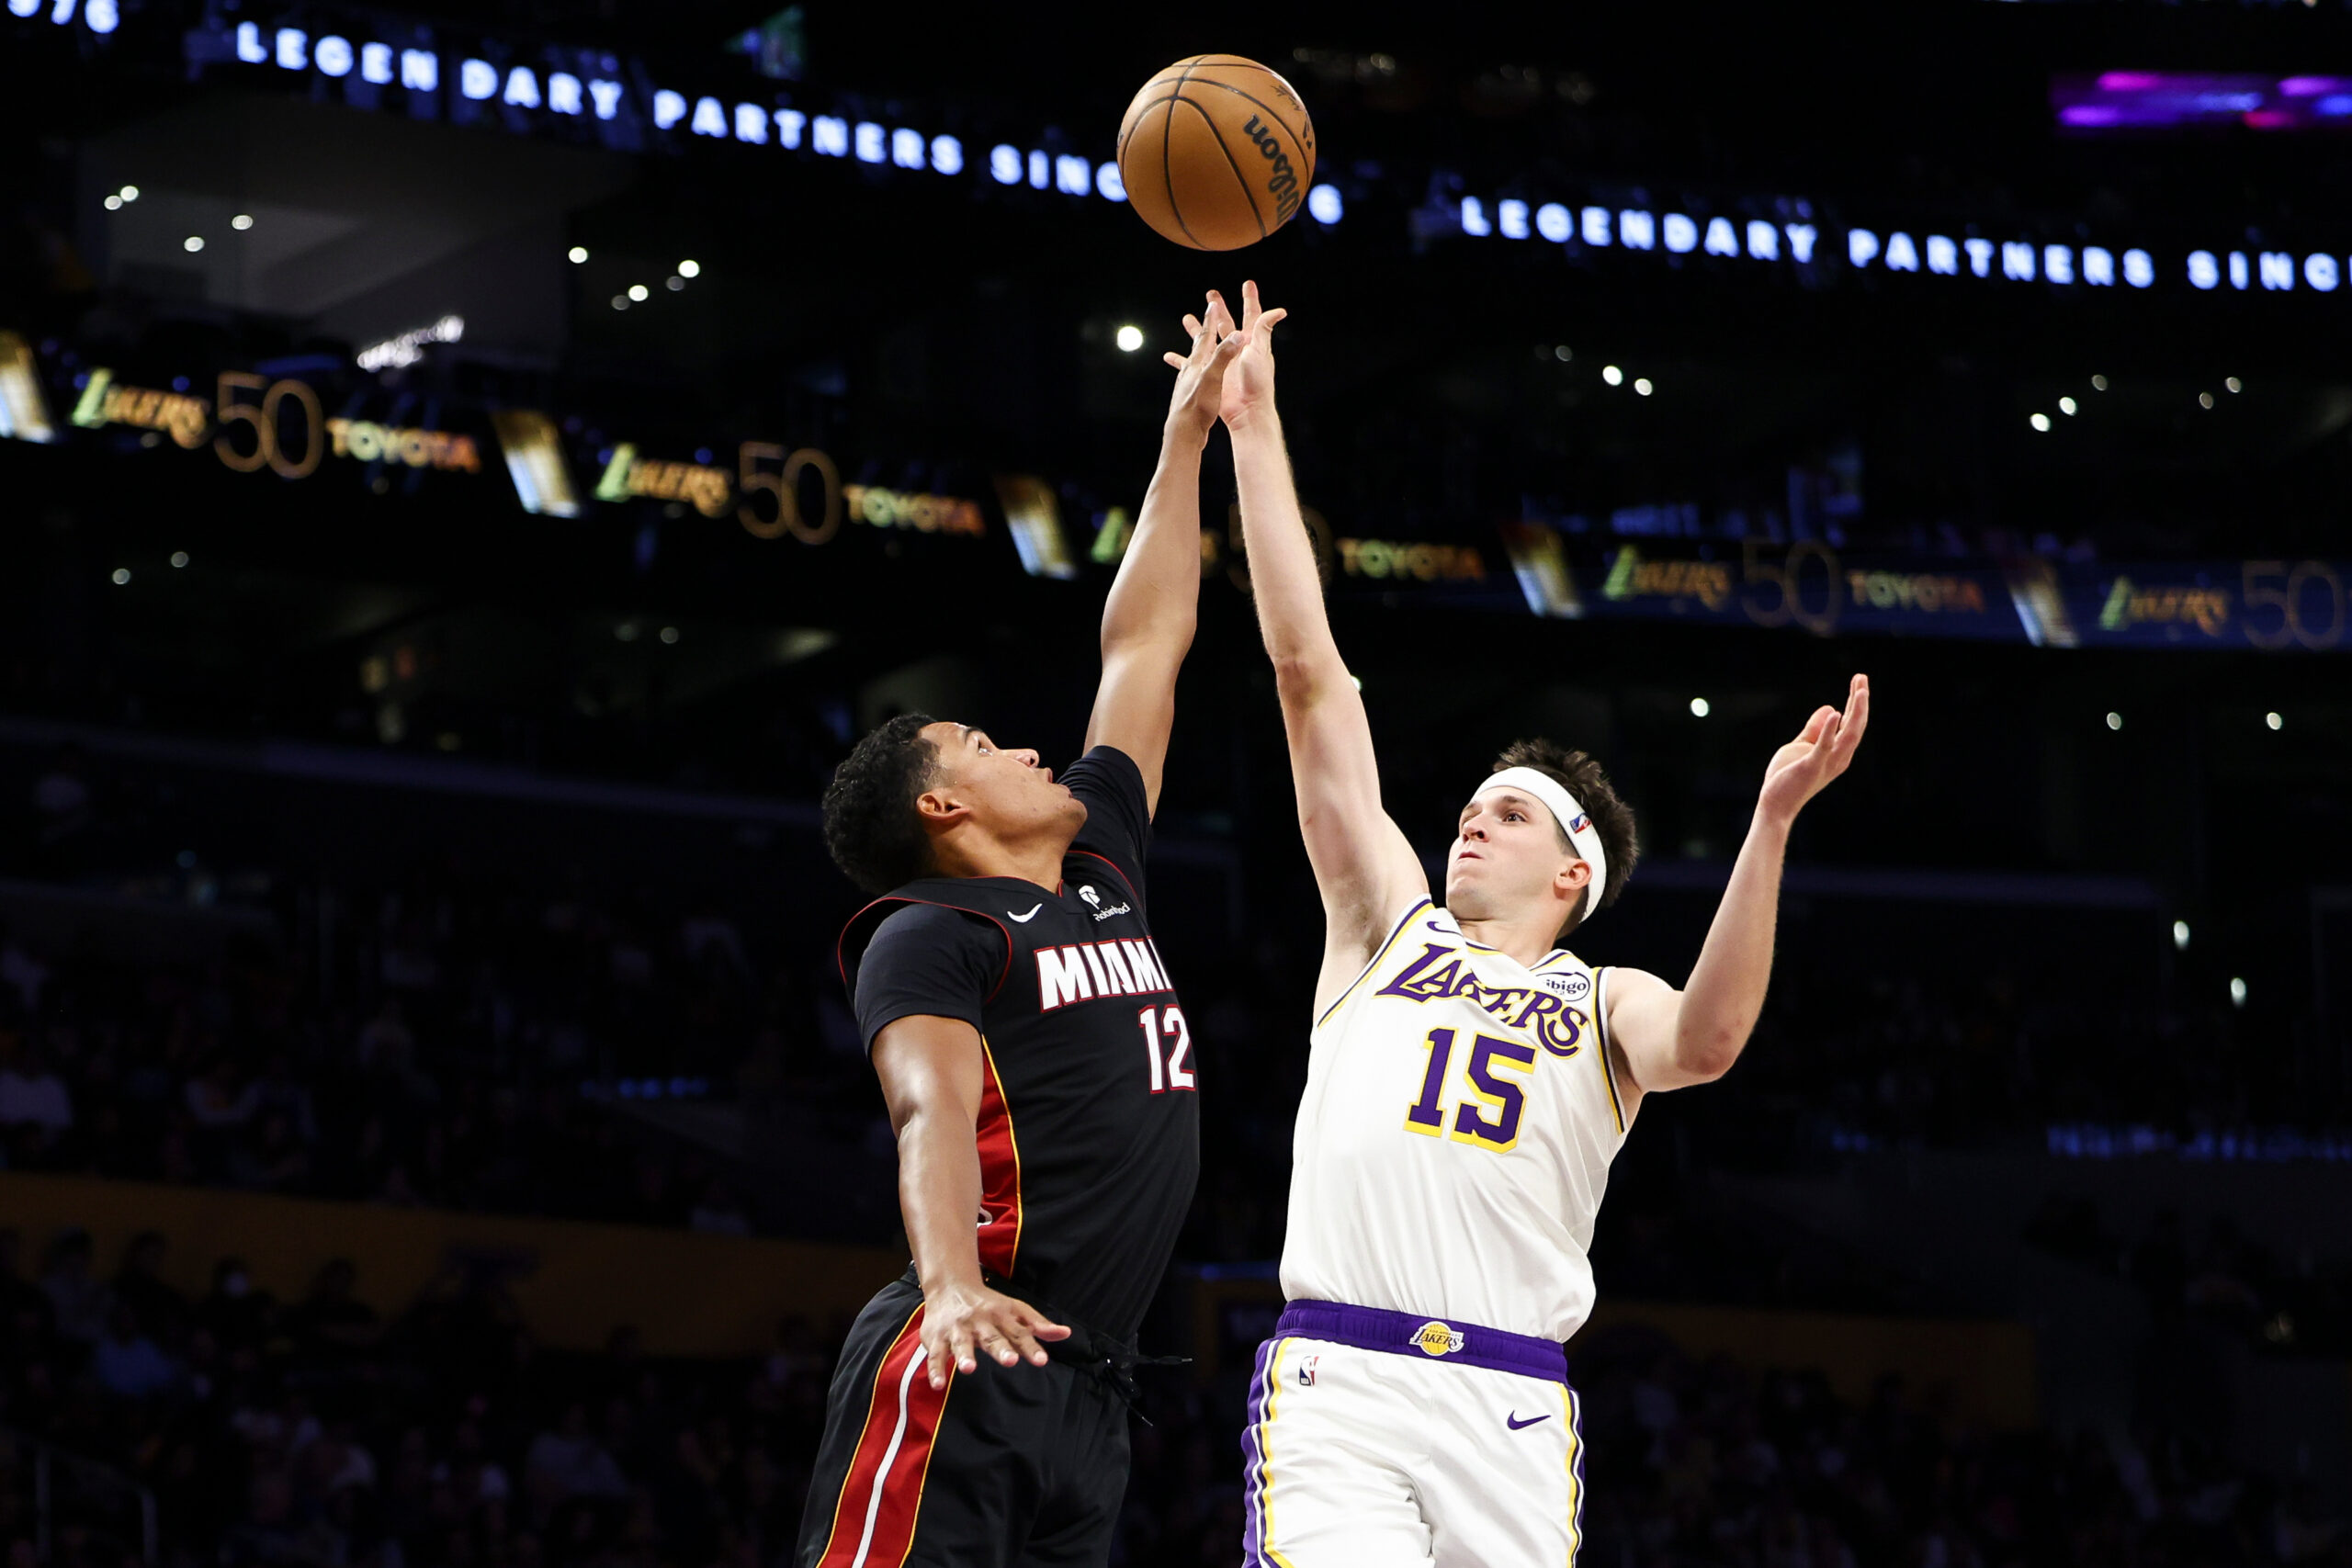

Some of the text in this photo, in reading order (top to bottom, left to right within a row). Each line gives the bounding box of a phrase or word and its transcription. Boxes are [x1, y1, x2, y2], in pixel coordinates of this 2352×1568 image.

[653, 89, 964, 175] PARTNERS
[1460, 196, 2352, 292] LEGENDARY PARTNERS SINC
[214, 370, 324, 479] 50
[737, 441, 842, 546] 50
[1034, 935, 1174, 1013] MIAMI
[1374, 942, 1588, 1058] LAKERS
[1137, 1004, 1196, 1094] 12
[1403, 1027, 1540, 1154] 15
[1412, 1328, 1462, 1351] LAKERS
